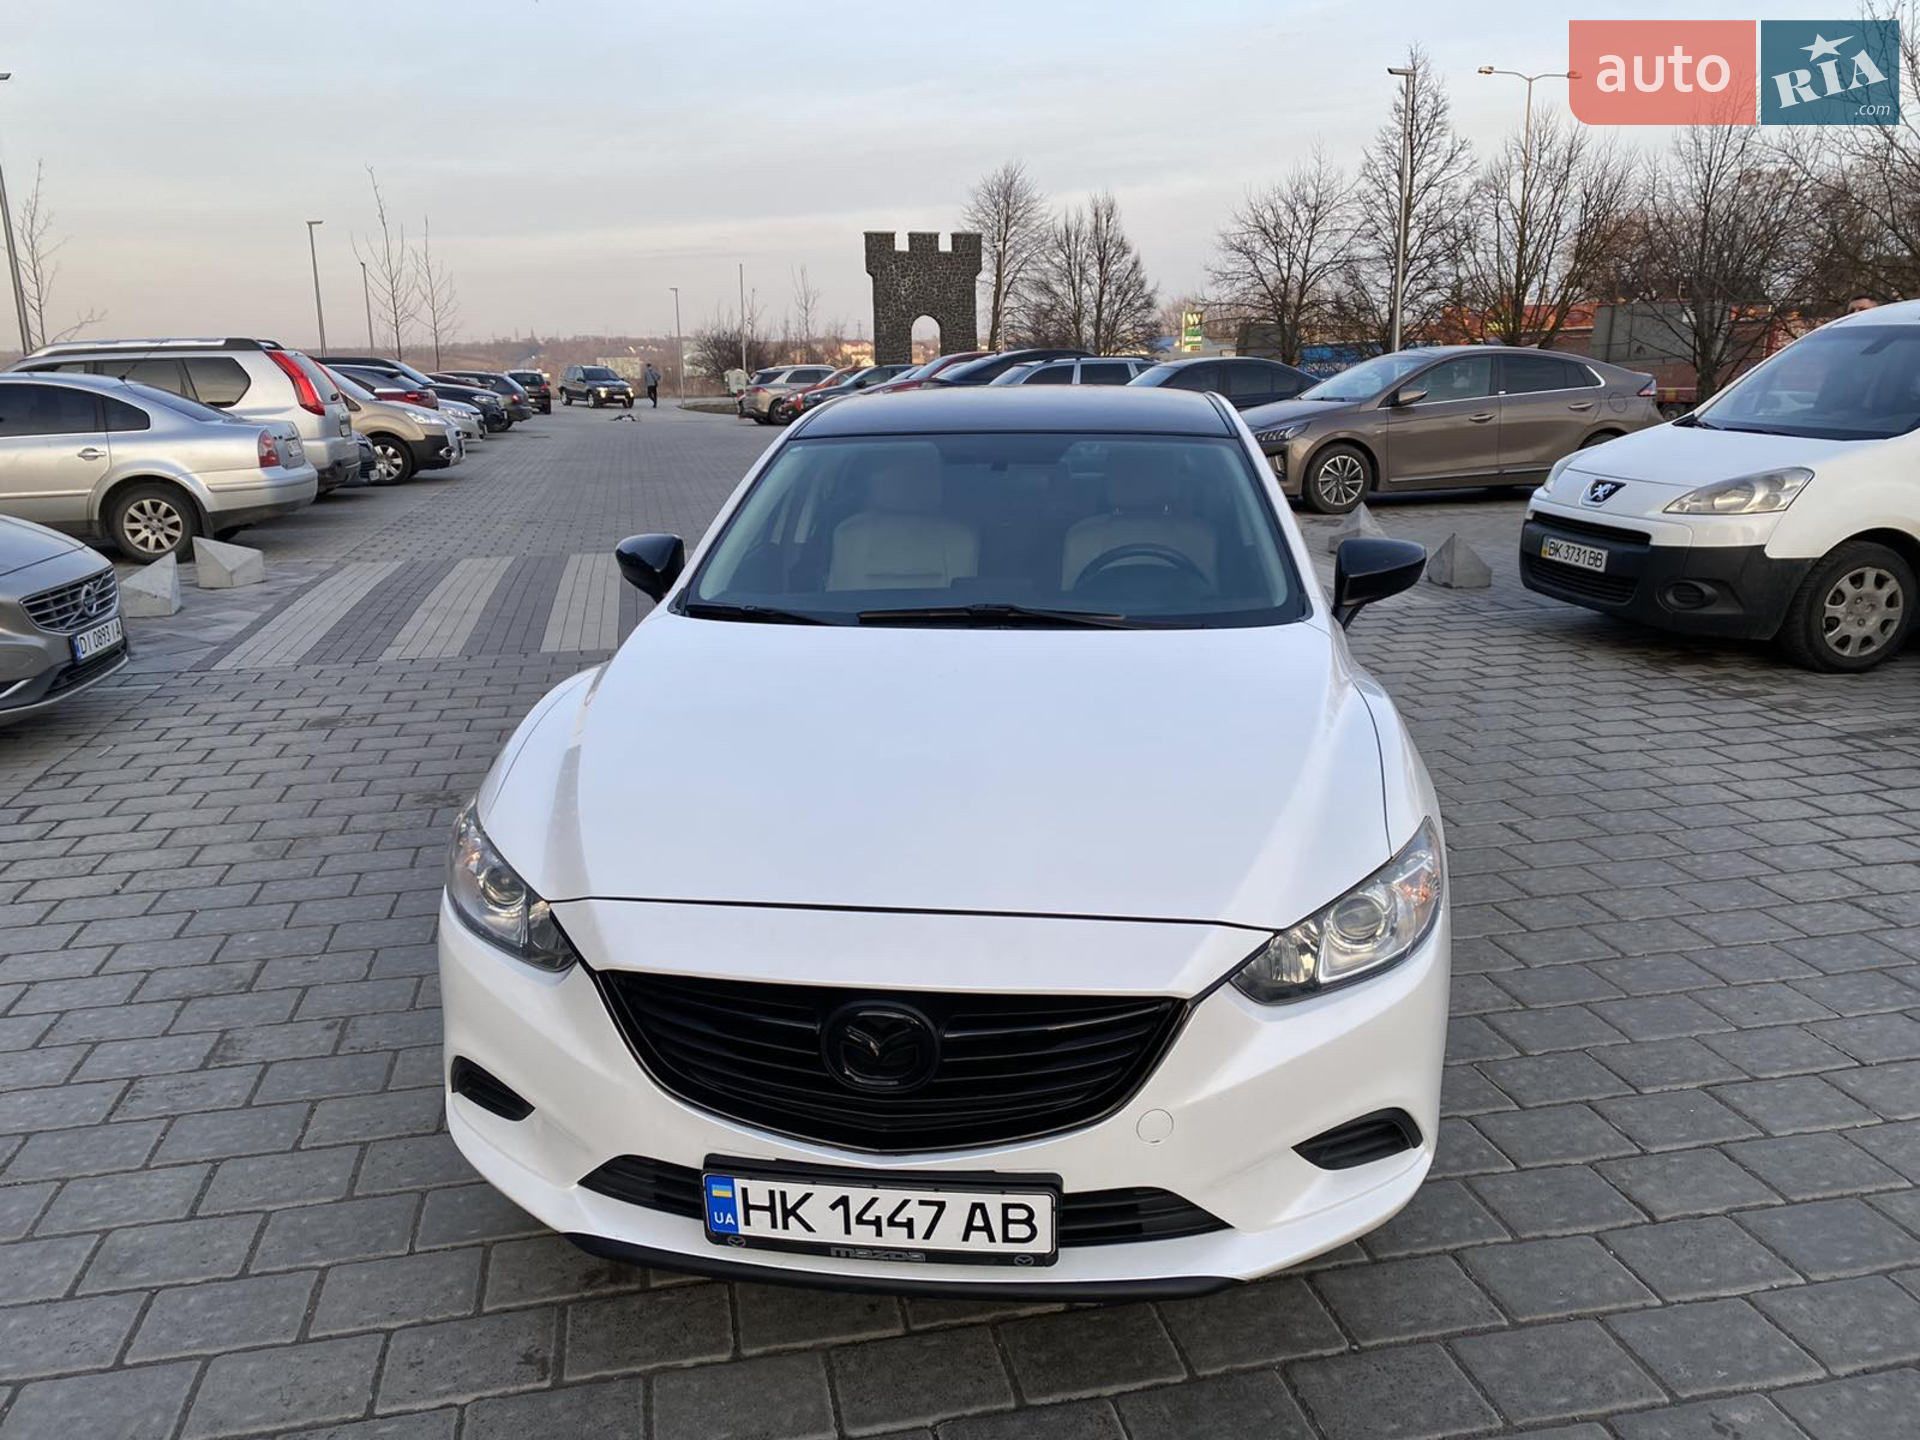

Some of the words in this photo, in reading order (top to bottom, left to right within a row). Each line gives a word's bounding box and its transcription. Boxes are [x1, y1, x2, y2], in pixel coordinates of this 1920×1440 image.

[1548, 541, 1563, 558] BK
[1564, 545, 1587, 564] 3731
[1587, 550, 1604, 568] BB
[79, 633, 92, 654] DI
[714, 1211, 735, 1225] UA
[741, 1187, 817, 1233] HK
[828, 1195, 946, 1241] 1447
[961, 1202, 1038, 1244] AB
